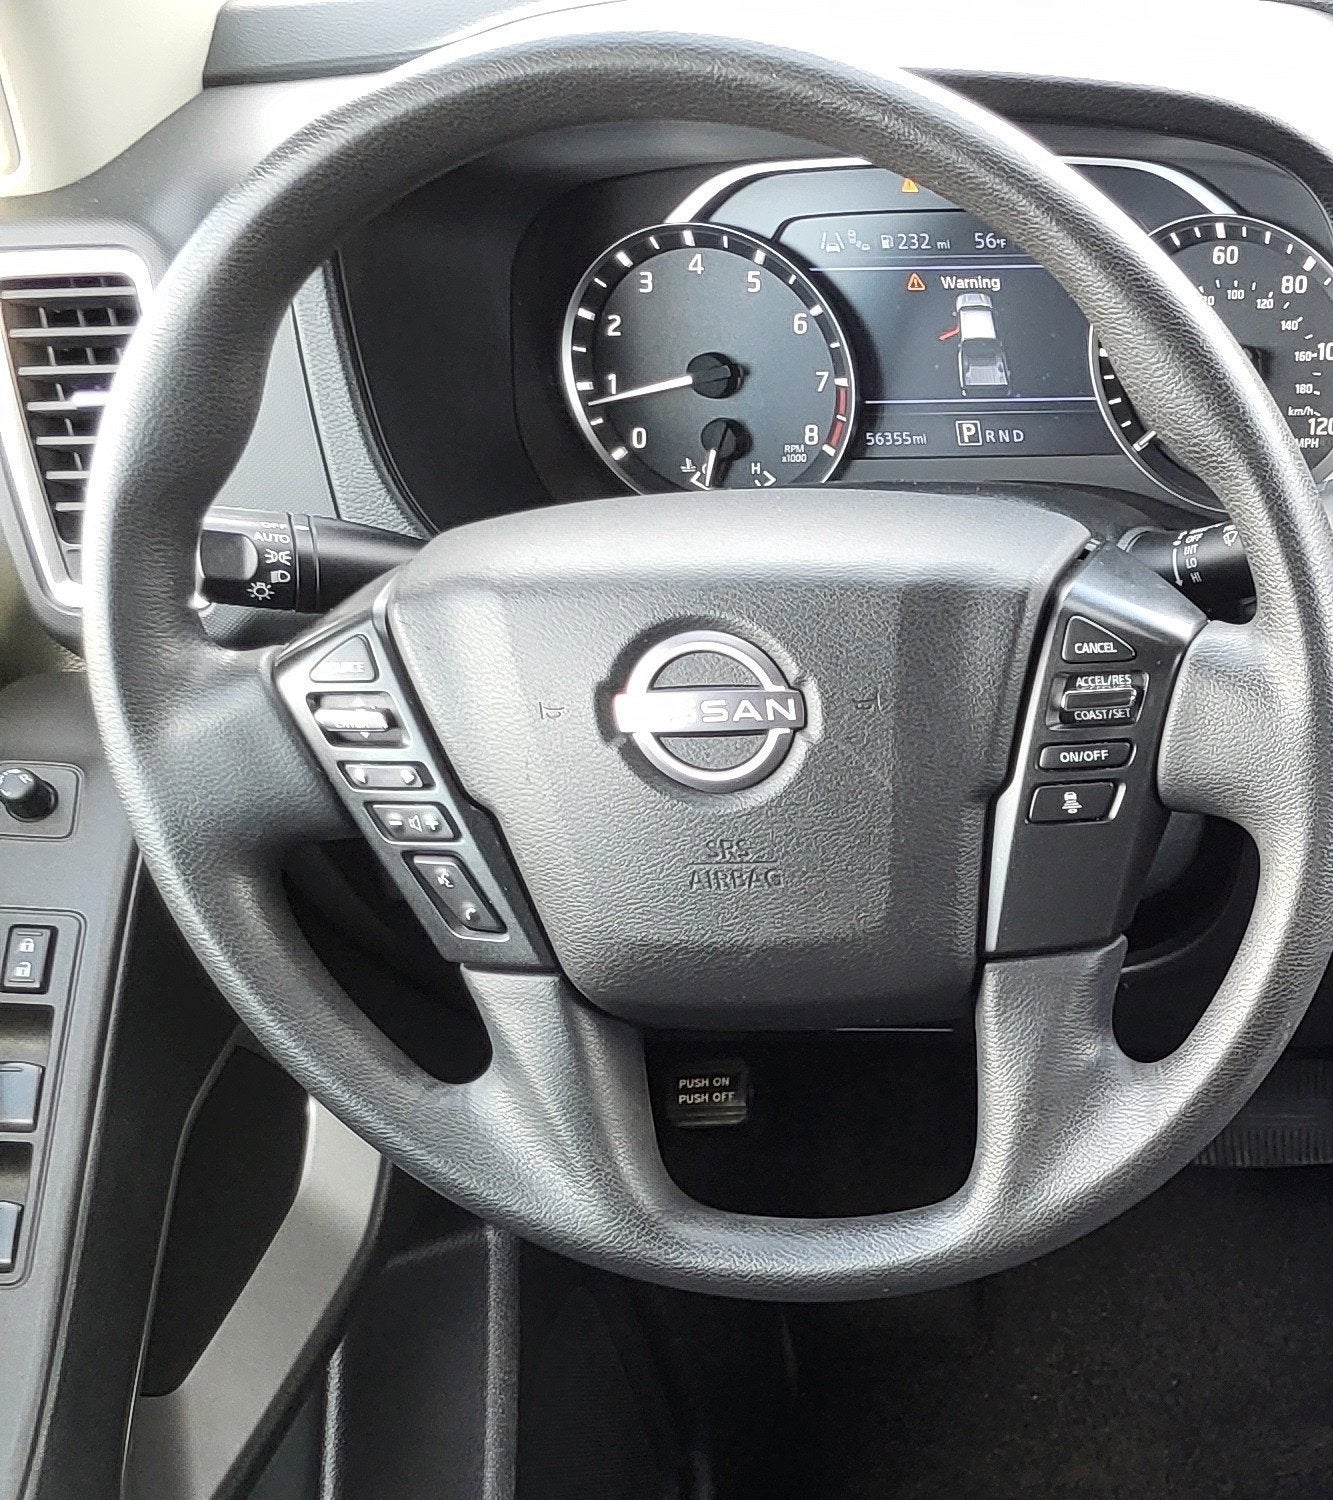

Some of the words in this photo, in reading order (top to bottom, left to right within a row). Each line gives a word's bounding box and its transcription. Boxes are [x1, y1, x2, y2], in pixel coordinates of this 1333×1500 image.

[898, 233, 931, 250] 232
[937, 238, 951, 250] mi
[1212, 245, 1239, 265] 60
[688, 254, 704, 275] 4
[639, 271, 653, 293] 3
[747, 271, 761, 293] 5
[941, 275, 1001, 291] Warning
[1281, 275, 1308, 294] 80
[1226, 289, 1245, 300] 100
[1256, 299, 1274, 309] 120
[607, 315, 622, 336] 2
[793, 314, 808, 335] 6
[1281, 320, 1299, 331] 140
[607, 374, 617, 393] 1
[815, 372, 829, 392] 7
[1288, 406, 1314, 416] km/h
[632, 427, 647, 449] 0
[804, 424, 819, 445] 8
[783, 443, 805, 453] RPM
[751, 462, 761, 474] H
[253, 531, 291, 544] AUTO
[1074, 642, 1118, 655] CANCEL
[1075, 674, 1132, 688] ACCEL/RES
[1073, 708, 1131, 721] COAST/SET
[1059, 750, 1109, 763] ON/OFF
[688, 868, 784, 892] AIRBAG
[678, 1078, 709, 1089] PUSH
[712, 1077, 730, 1087] ON
[678, 1092, 709, 1105] PUSH
[712, 1092, 735, 1103] OFF
